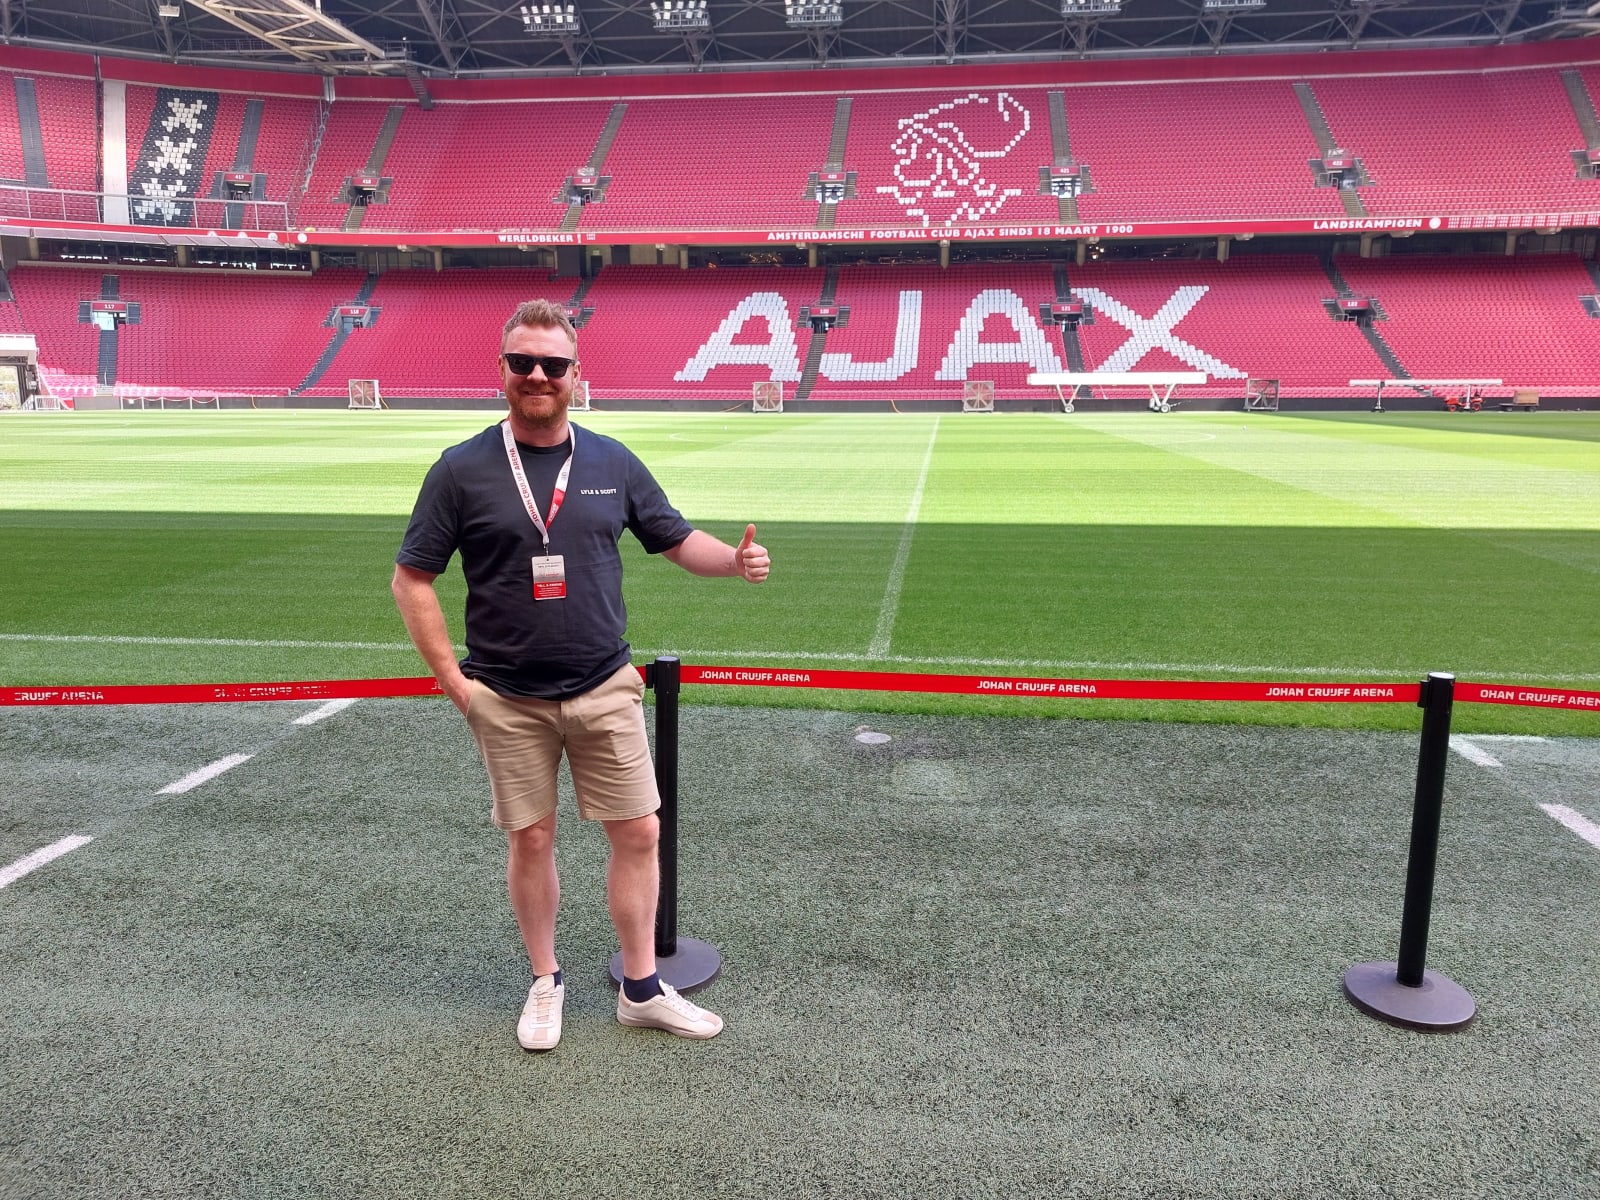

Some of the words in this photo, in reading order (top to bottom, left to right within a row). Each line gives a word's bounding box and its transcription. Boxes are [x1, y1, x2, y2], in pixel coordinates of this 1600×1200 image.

[1313, 219, 1422, 230] LANDSKAMPIOEN
[498, 234, 574, 243] WERELDBEKER
[767, 231, 865, 241] AMSTERDAMSCHE
[870, 230, 927, 239] FOOTBALL
[930, 229, 960, 238] CLUB
[964, 228, 995, 239] AJAX
[998, 227, 1033, 237] SINDS
[1037, 226, 1050, 236] 18
[1054, 226, 1098, 235] MAART
[1105, 225, 1133, 234] 1900
[673, 285, 1248, 382] AJAX
[699, 670, 733, 680] JOHAN
[775, 673, 811, 682] ARENA
[976, 680, 1013, 690] JOHAN
[1058, 684, 1097, 694] ARENA
[1265, 687, 1304, 697] JOHAN
[1353, 688, 1394, 697] ARENA
[1567, 696, 1600, 707] AREN
